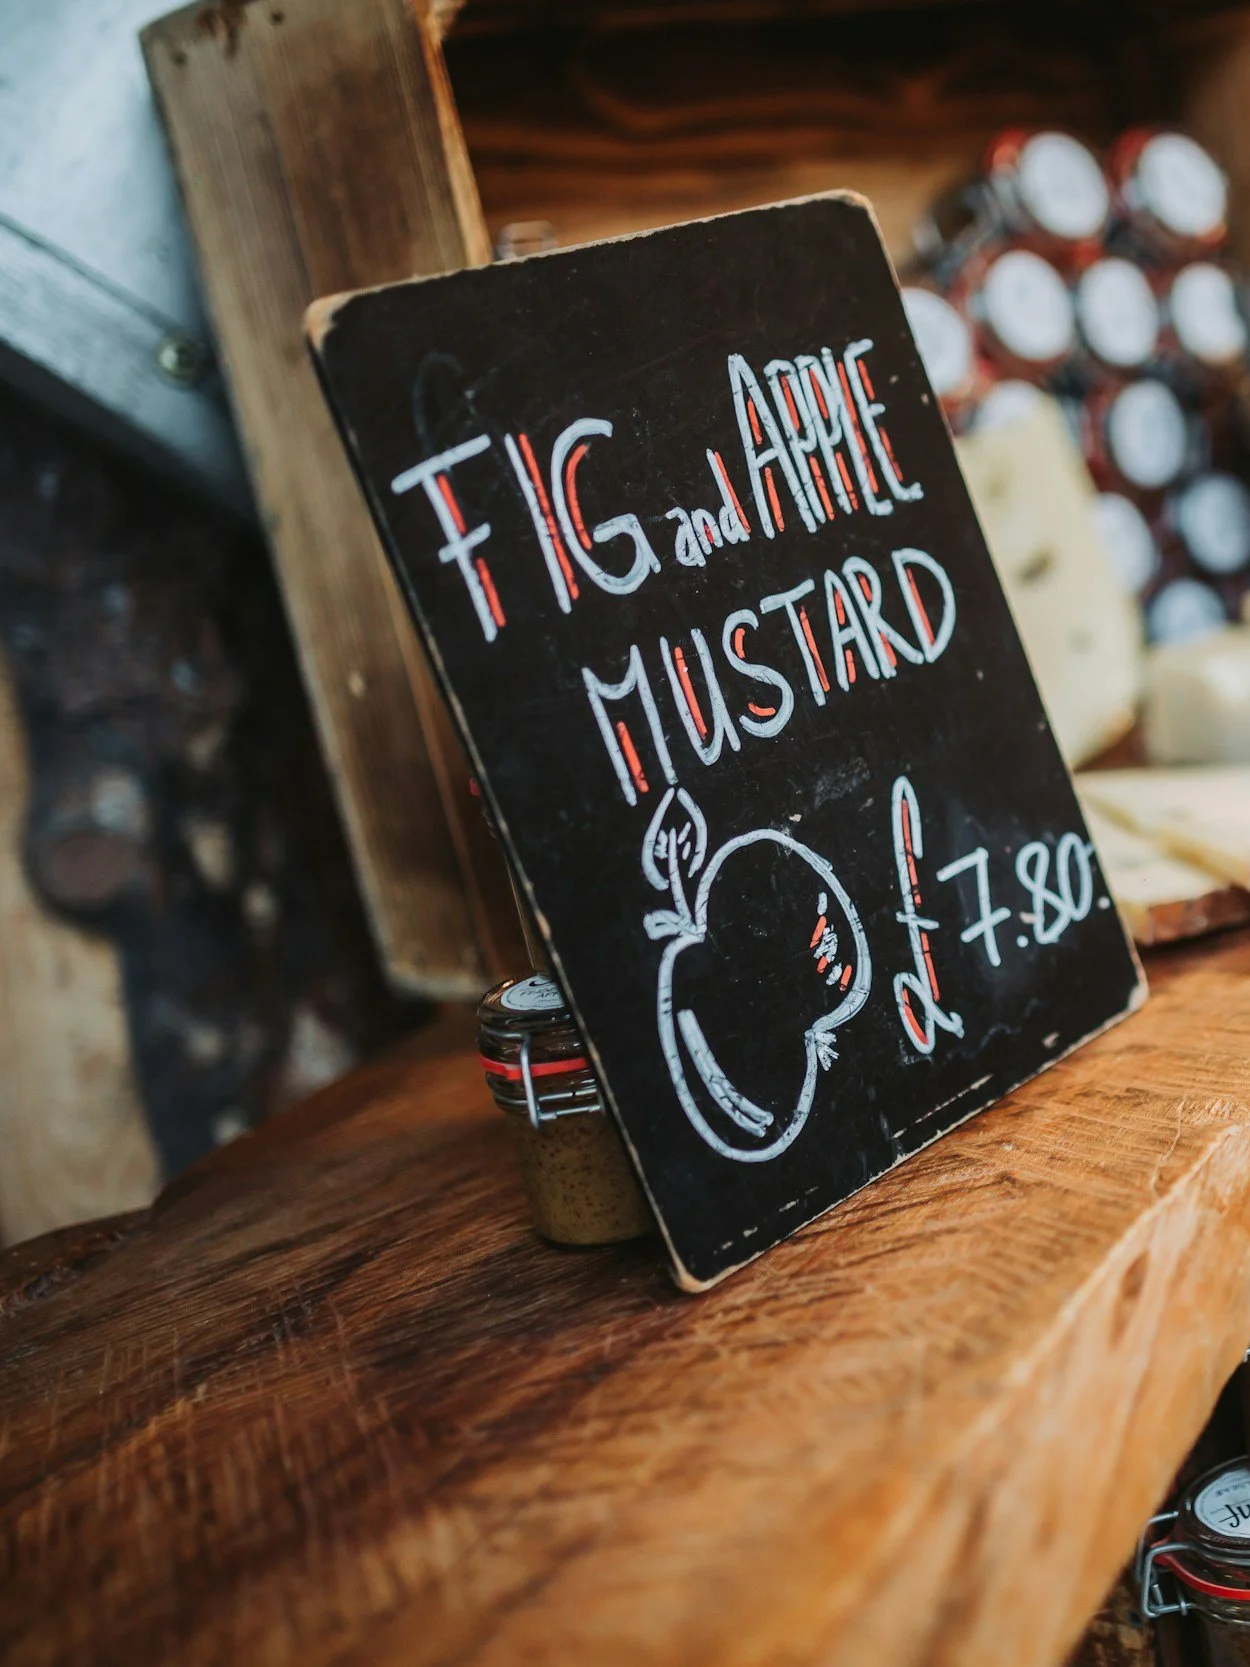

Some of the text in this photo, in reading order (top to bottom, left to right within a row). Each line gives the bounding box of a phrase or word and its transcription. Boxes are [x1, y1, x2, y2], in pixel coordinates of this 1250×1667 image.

[391, 338, 925, 643] FIG and APPLE
[581, 547, 956, 806] MUSTARD
